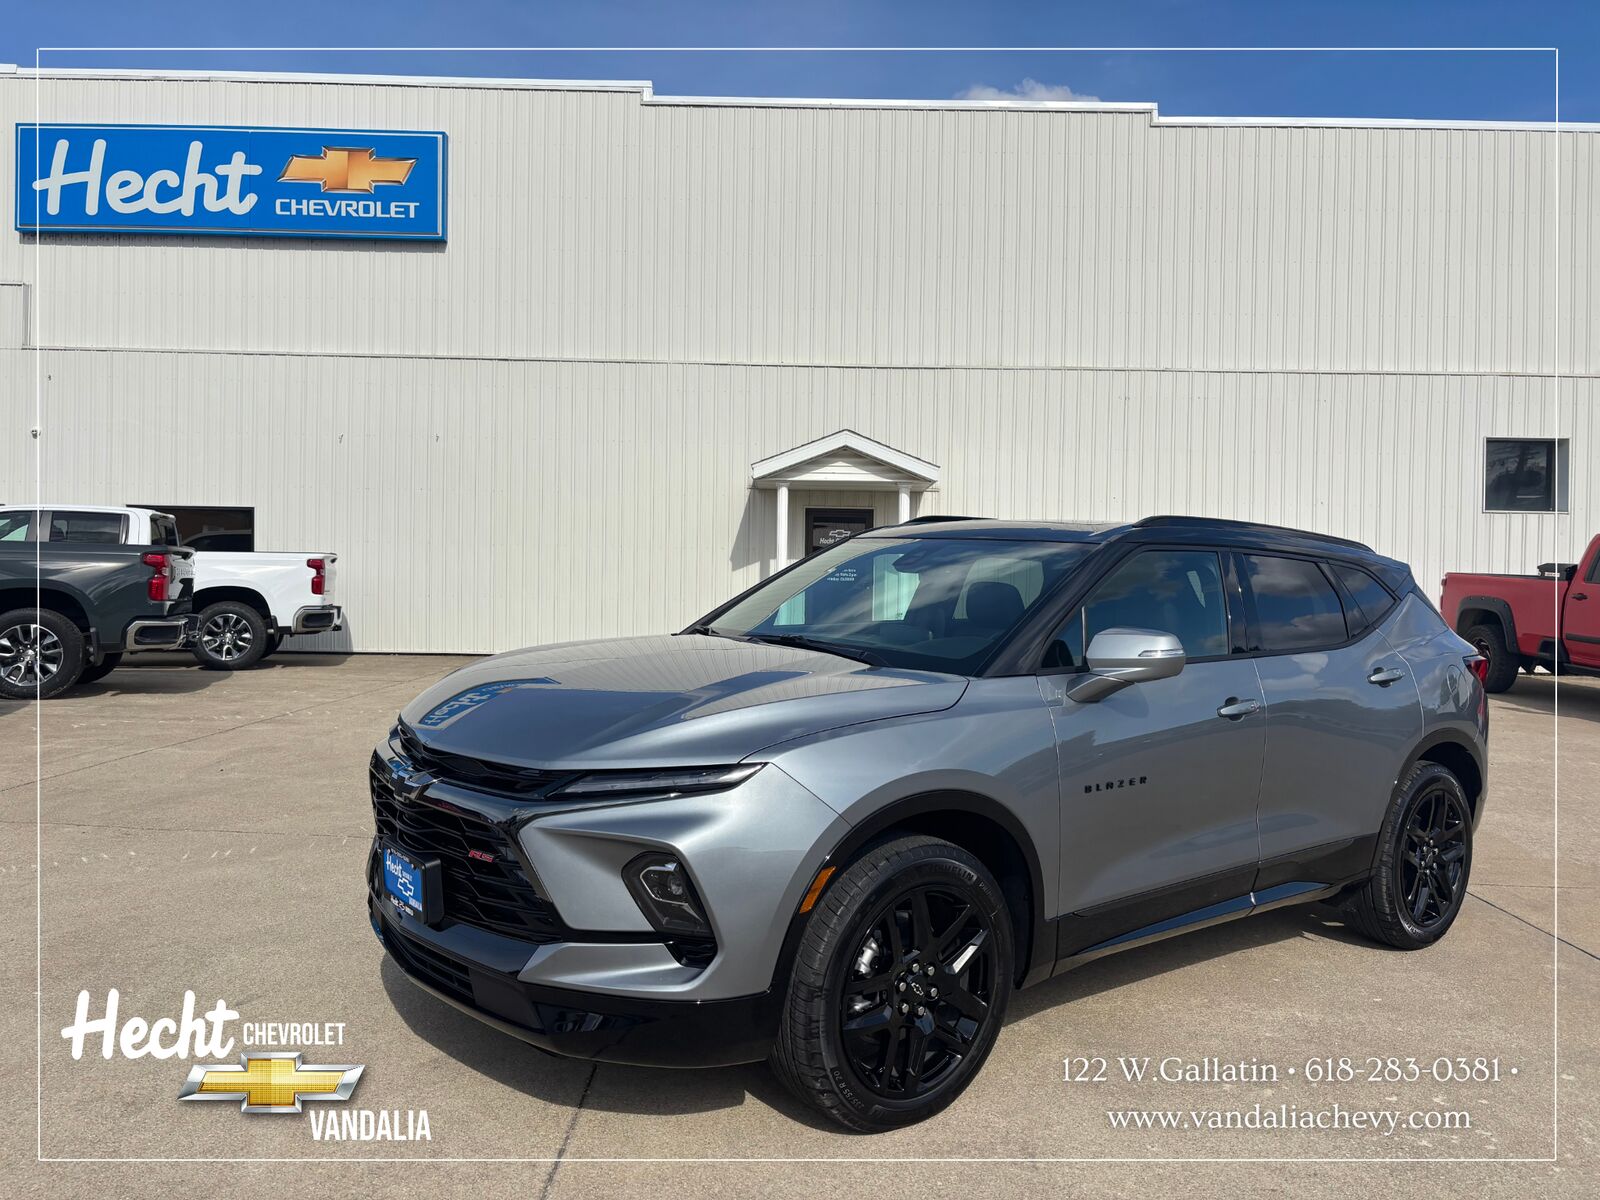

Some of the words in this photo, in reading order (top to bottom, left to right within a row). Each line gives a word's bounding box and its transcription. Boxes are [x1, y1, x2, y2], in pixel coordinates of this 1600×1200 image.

[33, 139, 262, 217] Hecht
[275, 199, 420, 218] CHEVROLET
[1084, 776, 1148, 794] BLAZER
